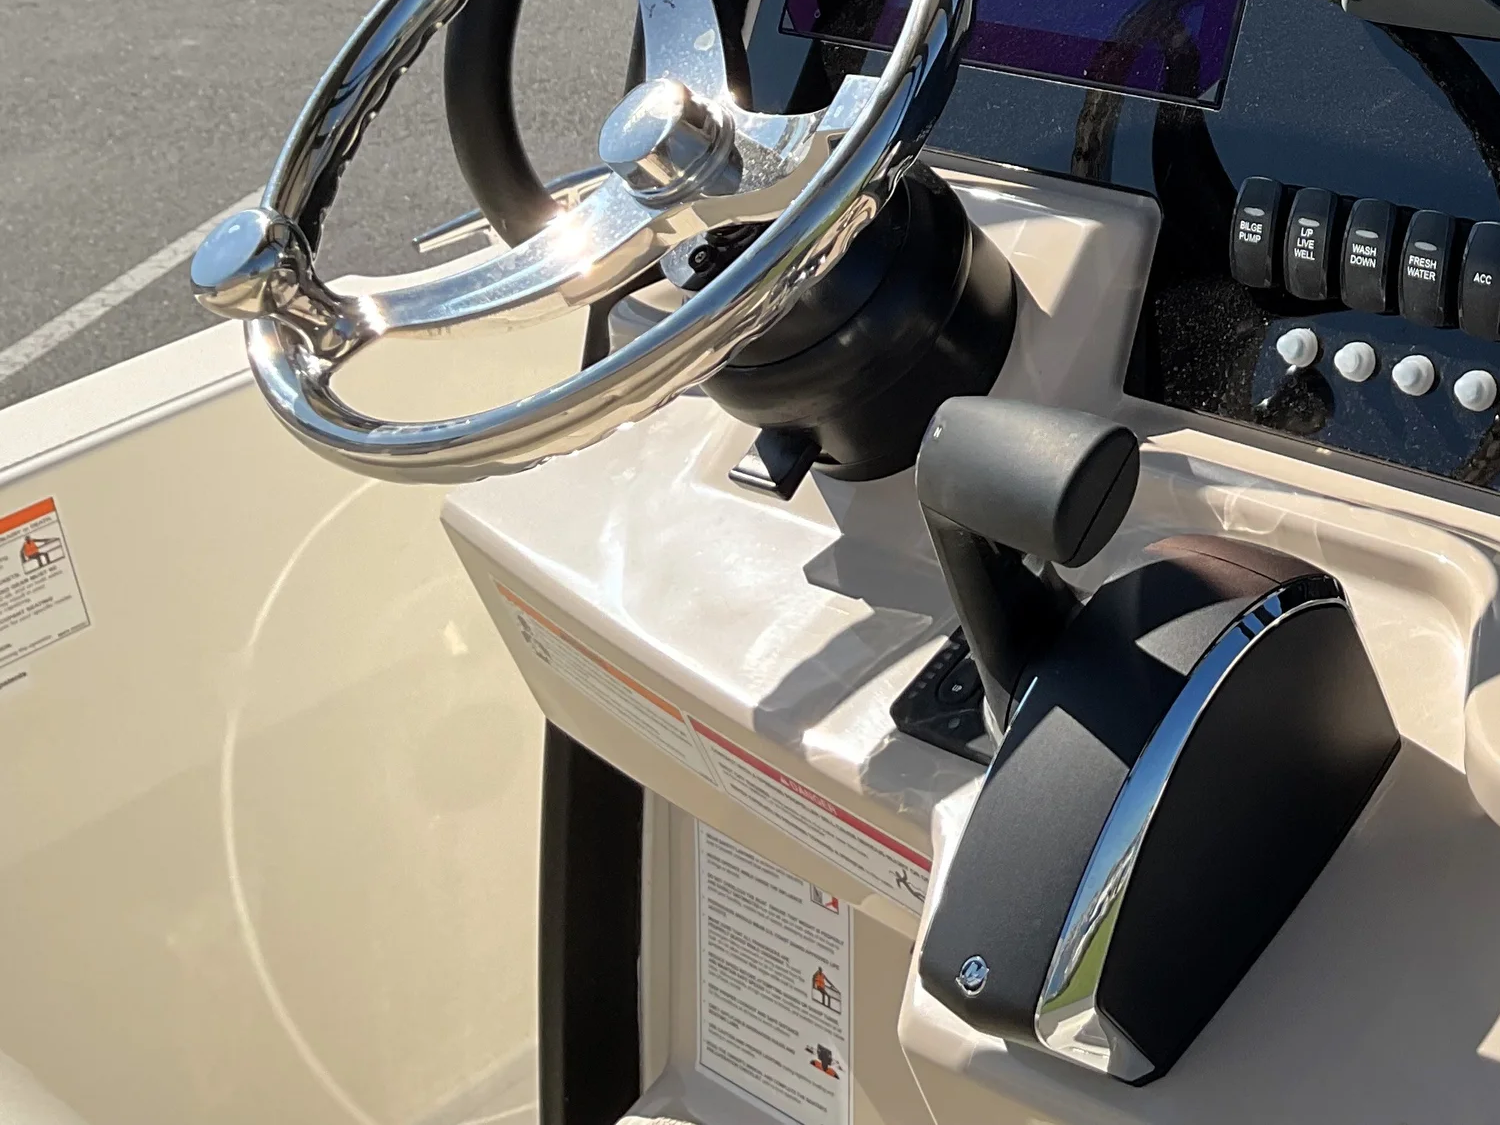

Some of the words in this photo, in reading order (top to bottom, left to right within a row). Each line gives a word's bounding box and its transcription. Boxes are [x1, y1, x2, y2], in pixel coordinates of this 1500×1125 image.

[1239, 220, 1263, 234] BILGE
[1300, 227, 1314, 238] L/P
[1238, 232, 1262, 244] PUMP
[1297, 238, 1315, 250] LIVE
[1294, 247, 1316, 261] WELL
[1352, 243, 1377, 257] WASH
[1350, 255, 1376, 268] DOWN
[1408, 255, 1437, 270] FRESH
[1407, 267, 1436, 281] WATER
[1473, 272, 1492, 285] ACC
[788, 779, 838, 816] DANGER
